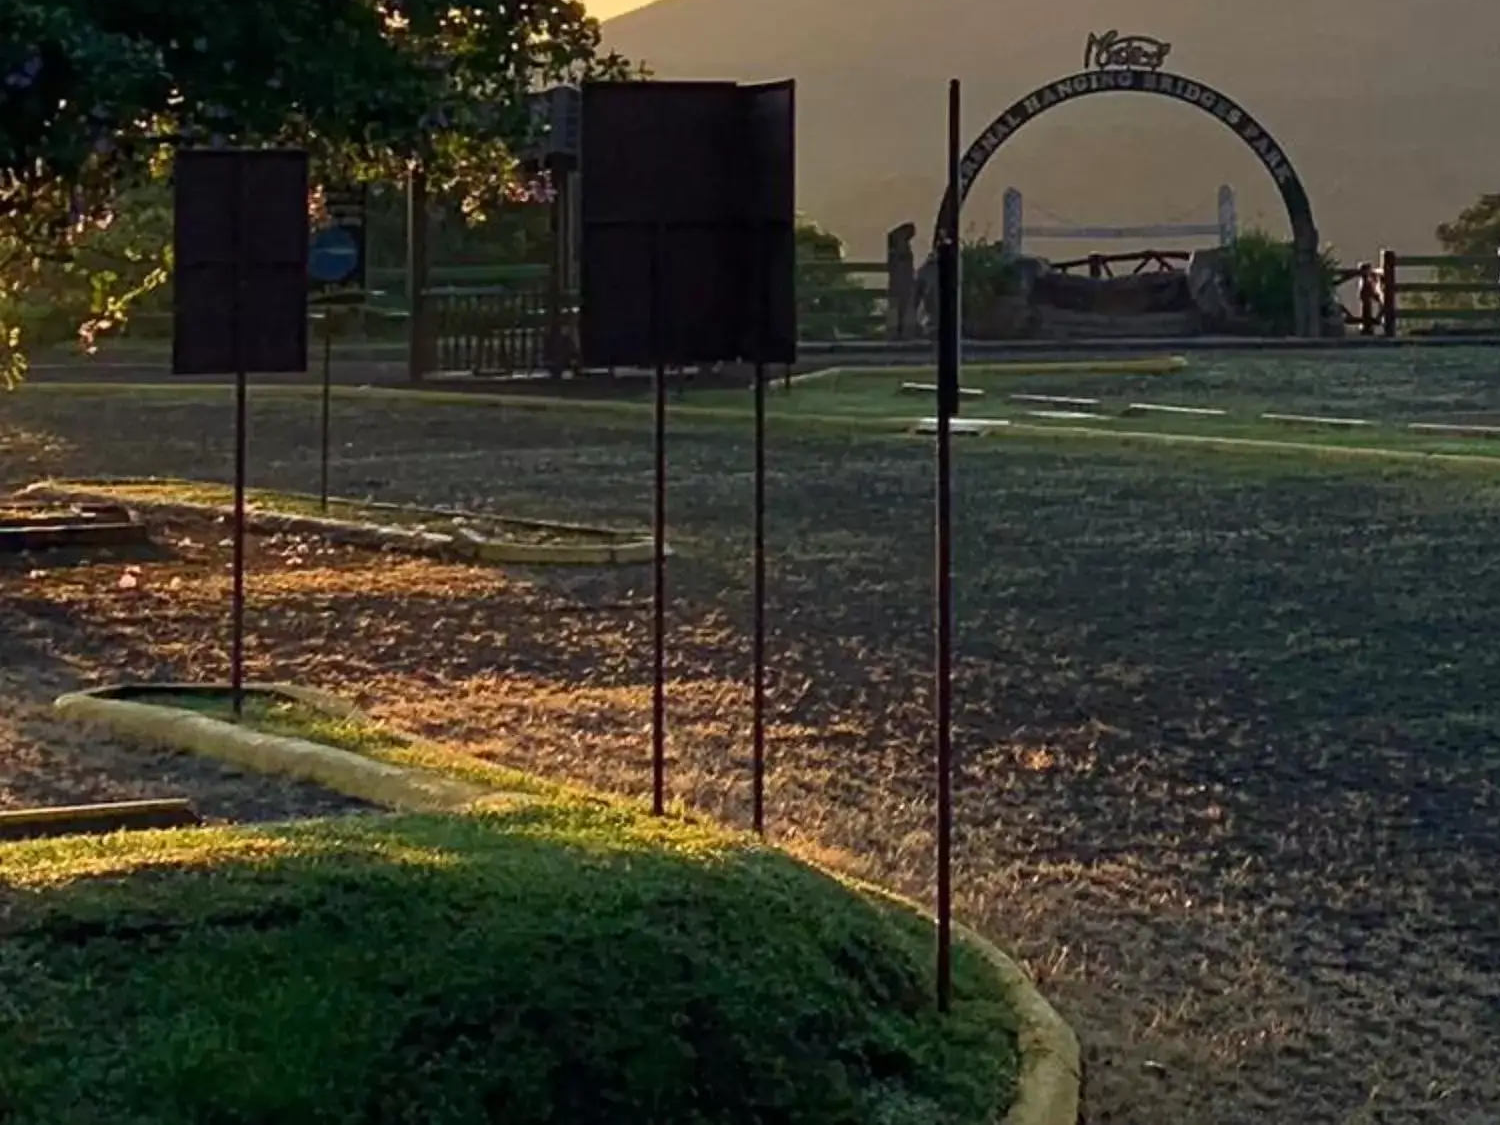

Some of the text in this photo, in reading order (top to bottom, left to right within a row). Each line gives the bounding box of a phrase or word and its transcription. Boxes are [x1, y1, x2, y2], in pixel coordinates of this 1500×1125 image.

[1024, 72, 1133, 114] HANGING
[1143, 73, 1243, 124] BRIDGES
[1244, 122, 1291, 183] PARK
